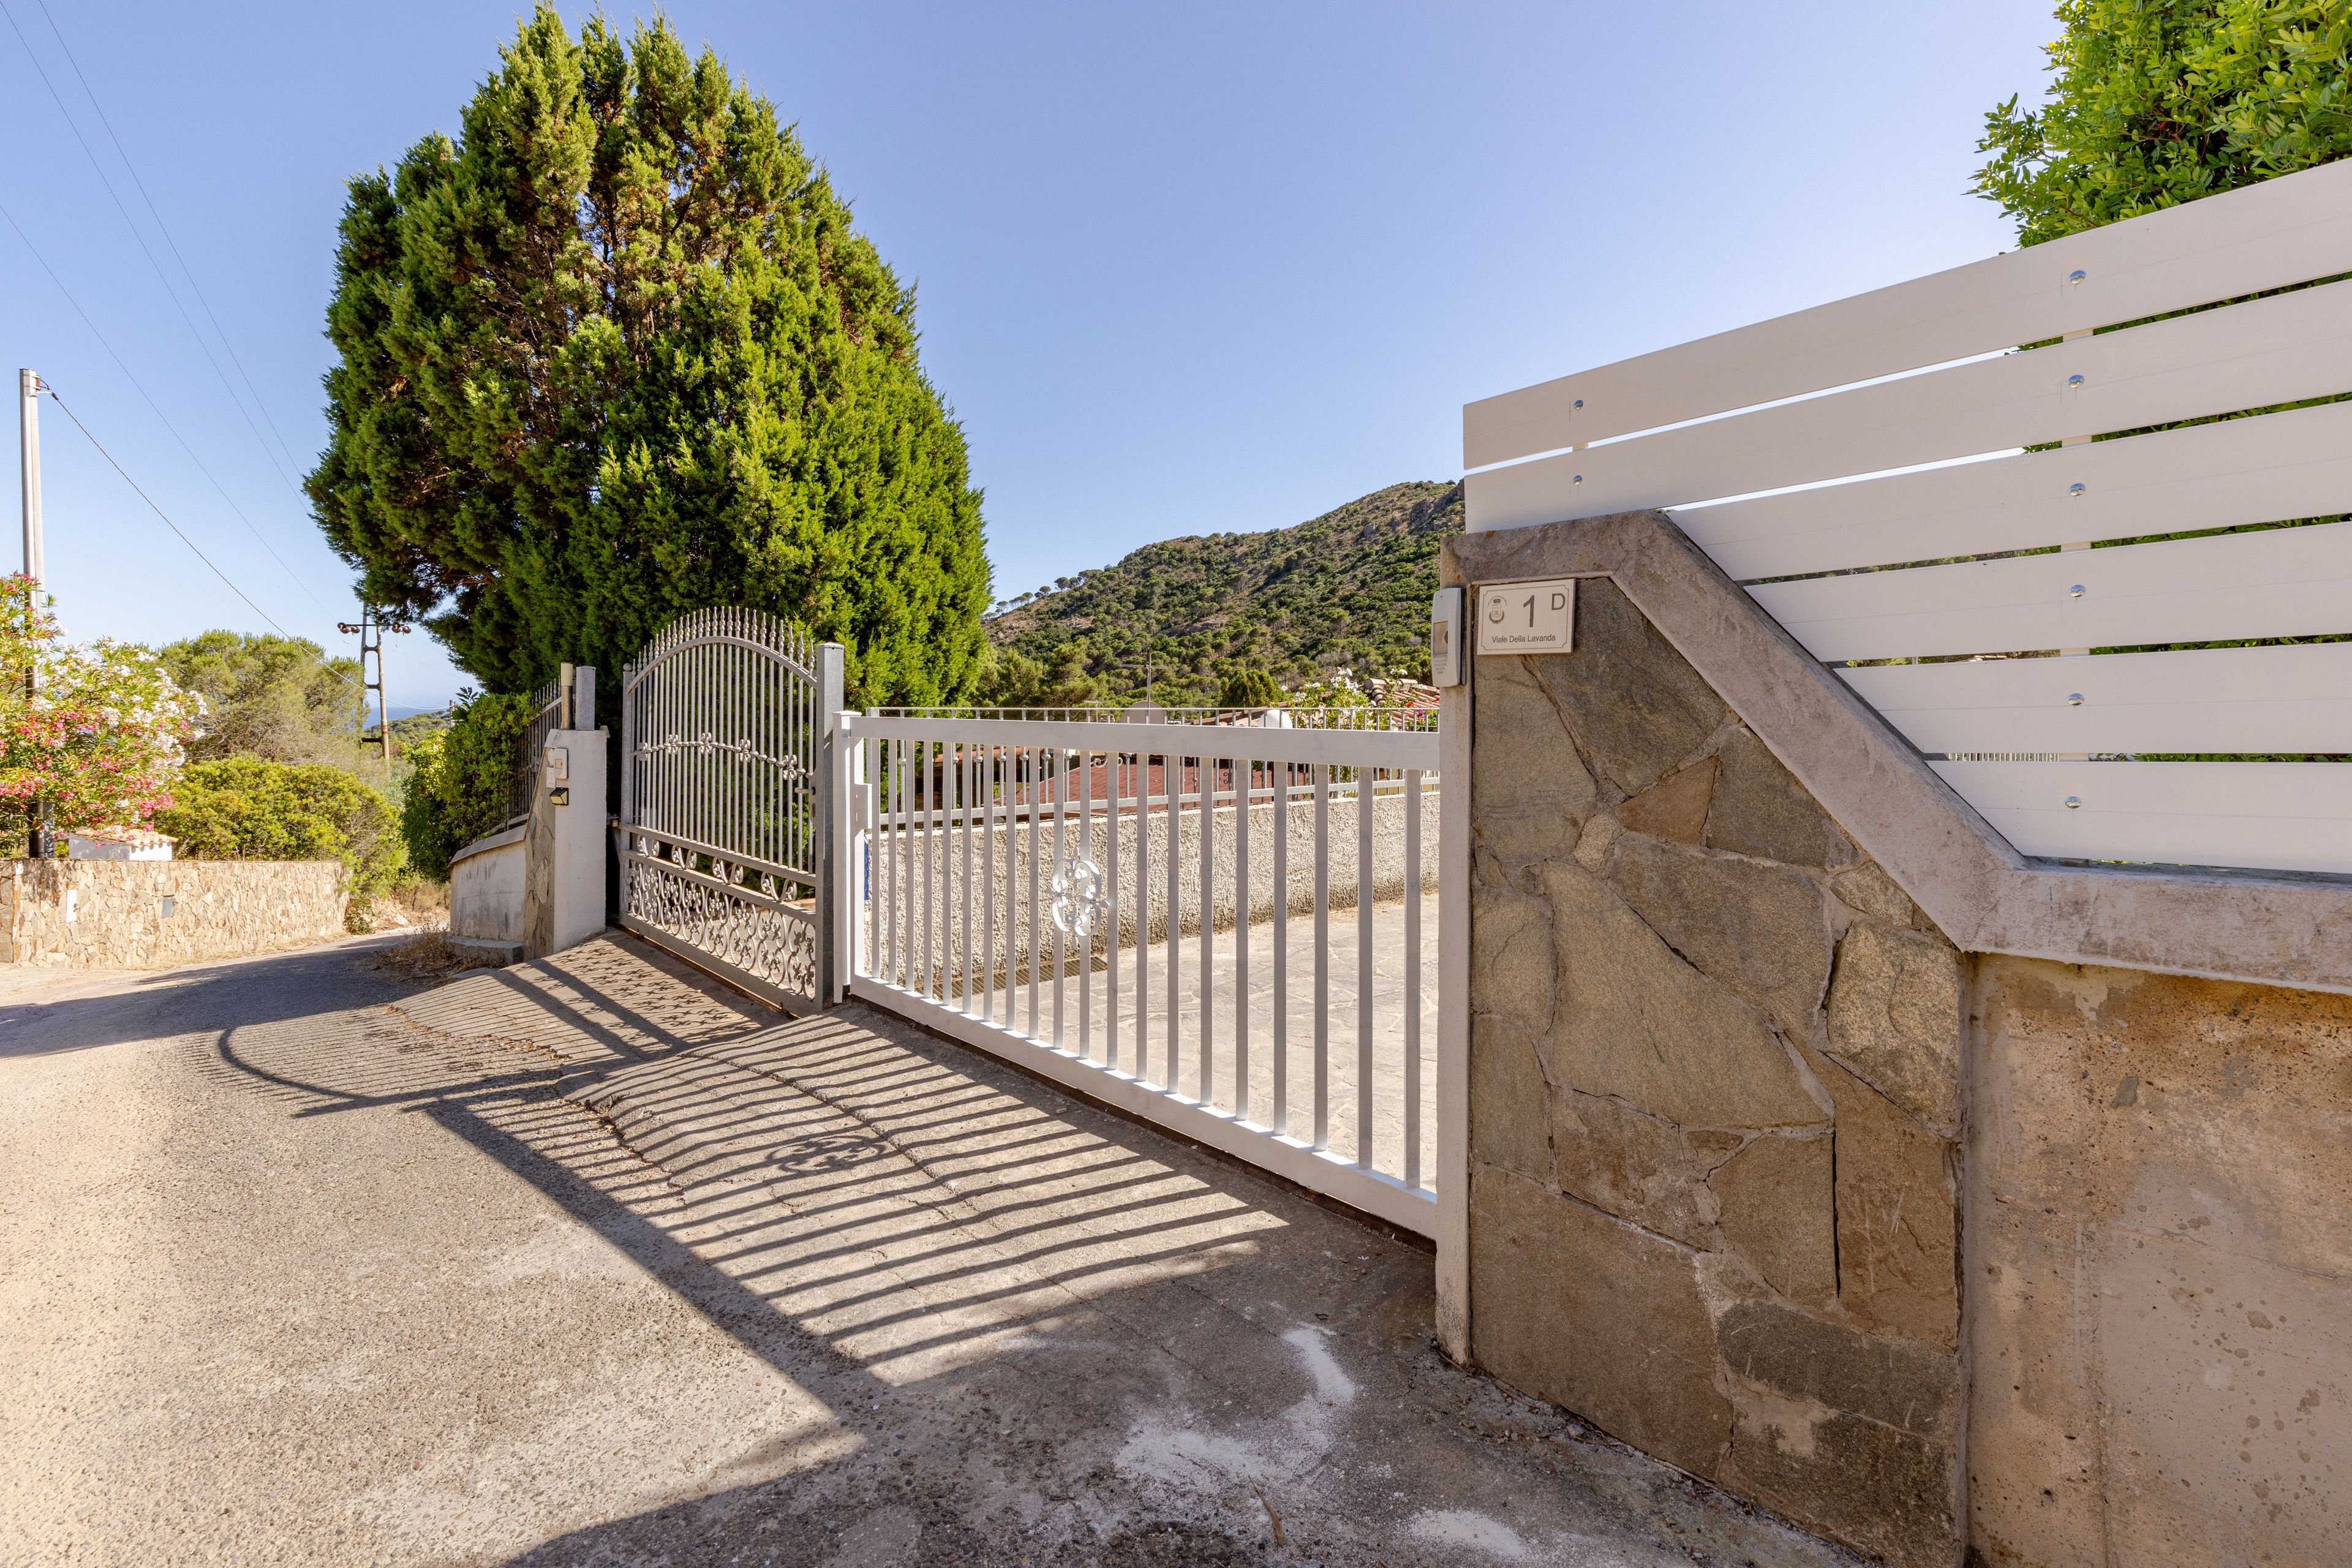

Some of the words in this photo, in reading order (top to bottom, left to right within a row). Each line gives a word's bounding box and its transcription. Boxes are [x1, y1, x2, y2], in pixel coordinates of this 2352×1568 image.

[1523, 595, 1534, 627] 1
[1551, 593, 1566, 611] D
[1528, 633, 1556, 642] Lavanda
